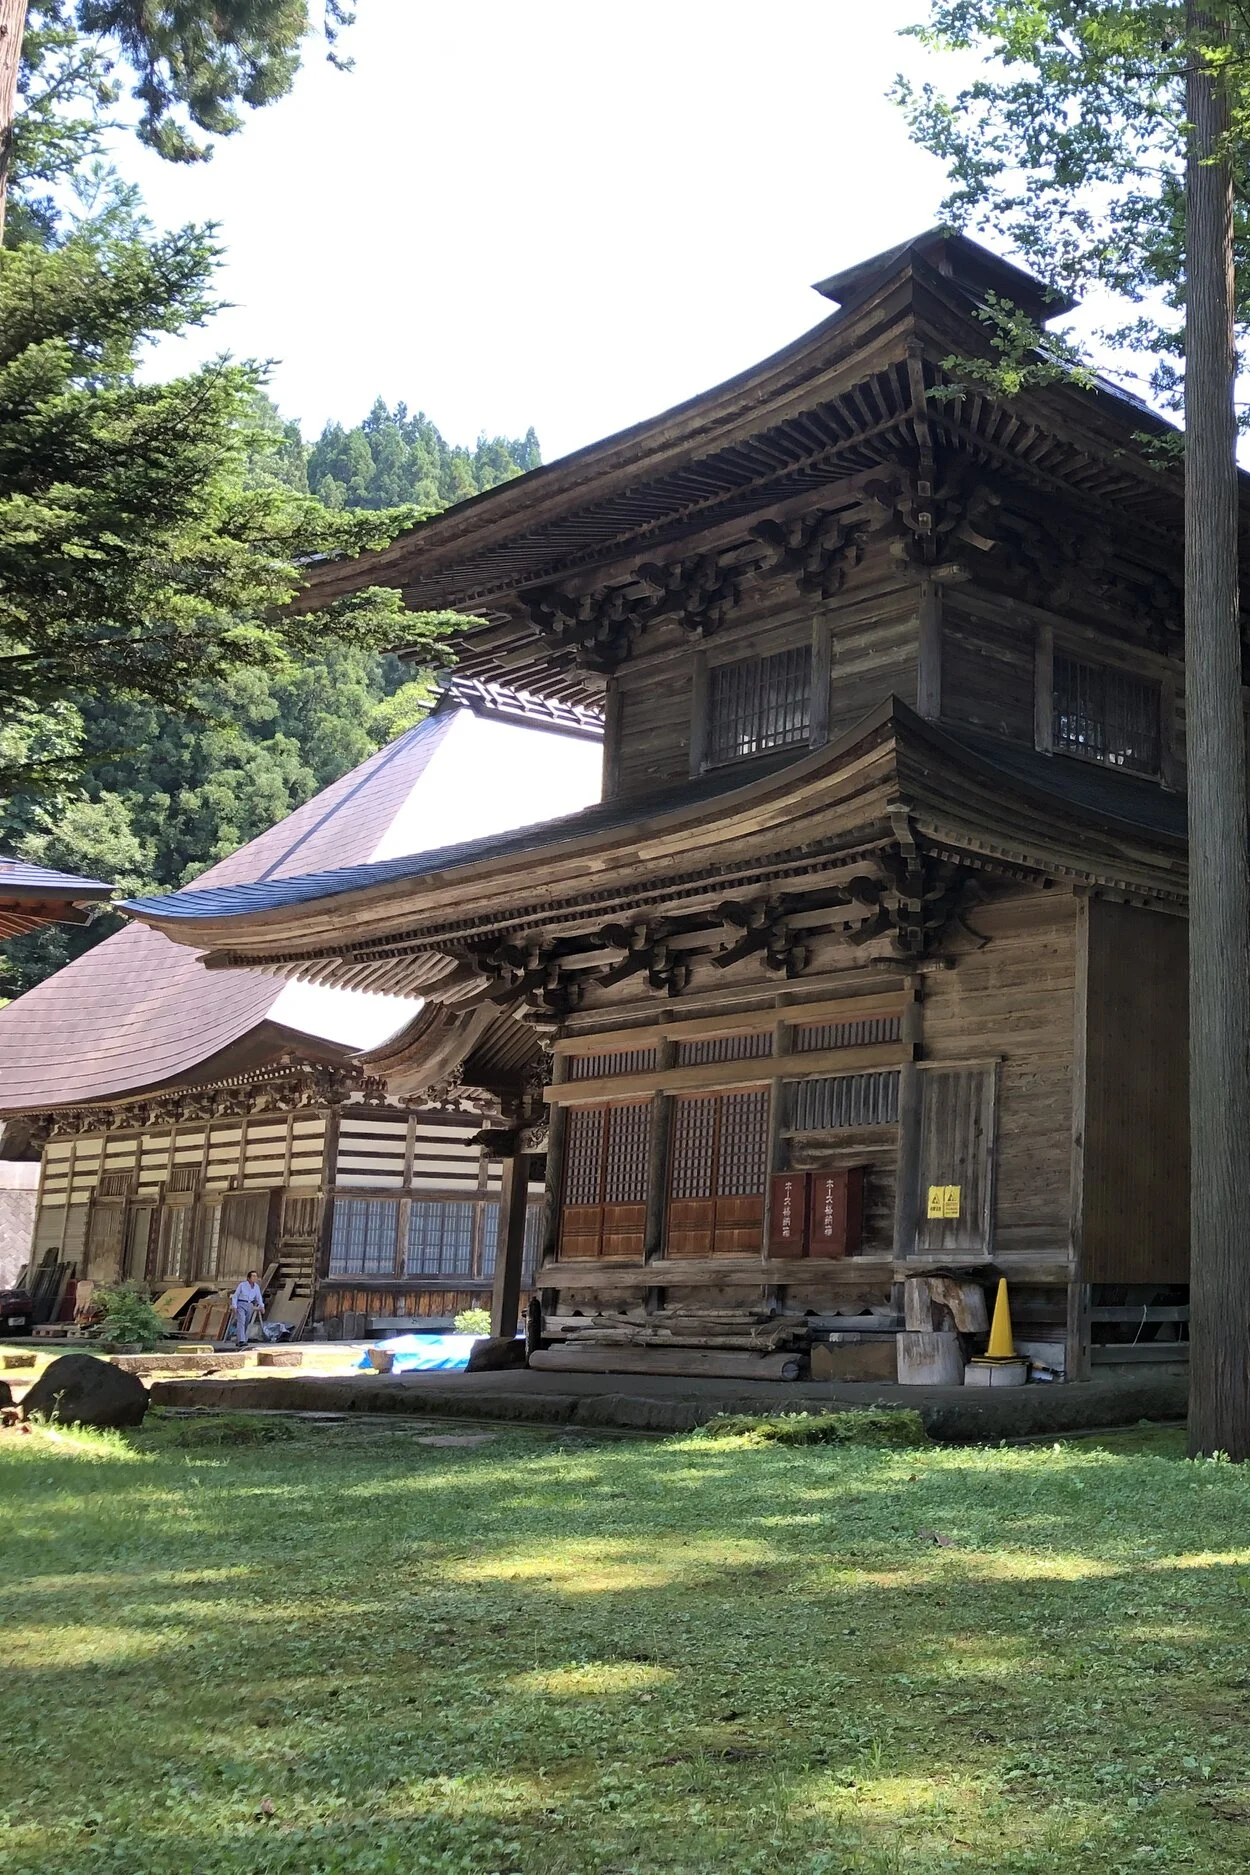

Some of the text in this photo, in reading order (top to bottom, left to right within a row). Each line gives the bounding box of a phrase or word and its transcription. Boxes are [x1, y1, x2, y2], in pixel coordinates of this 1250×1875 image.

[824, 1179, 835, 1236] ホース格納箱
